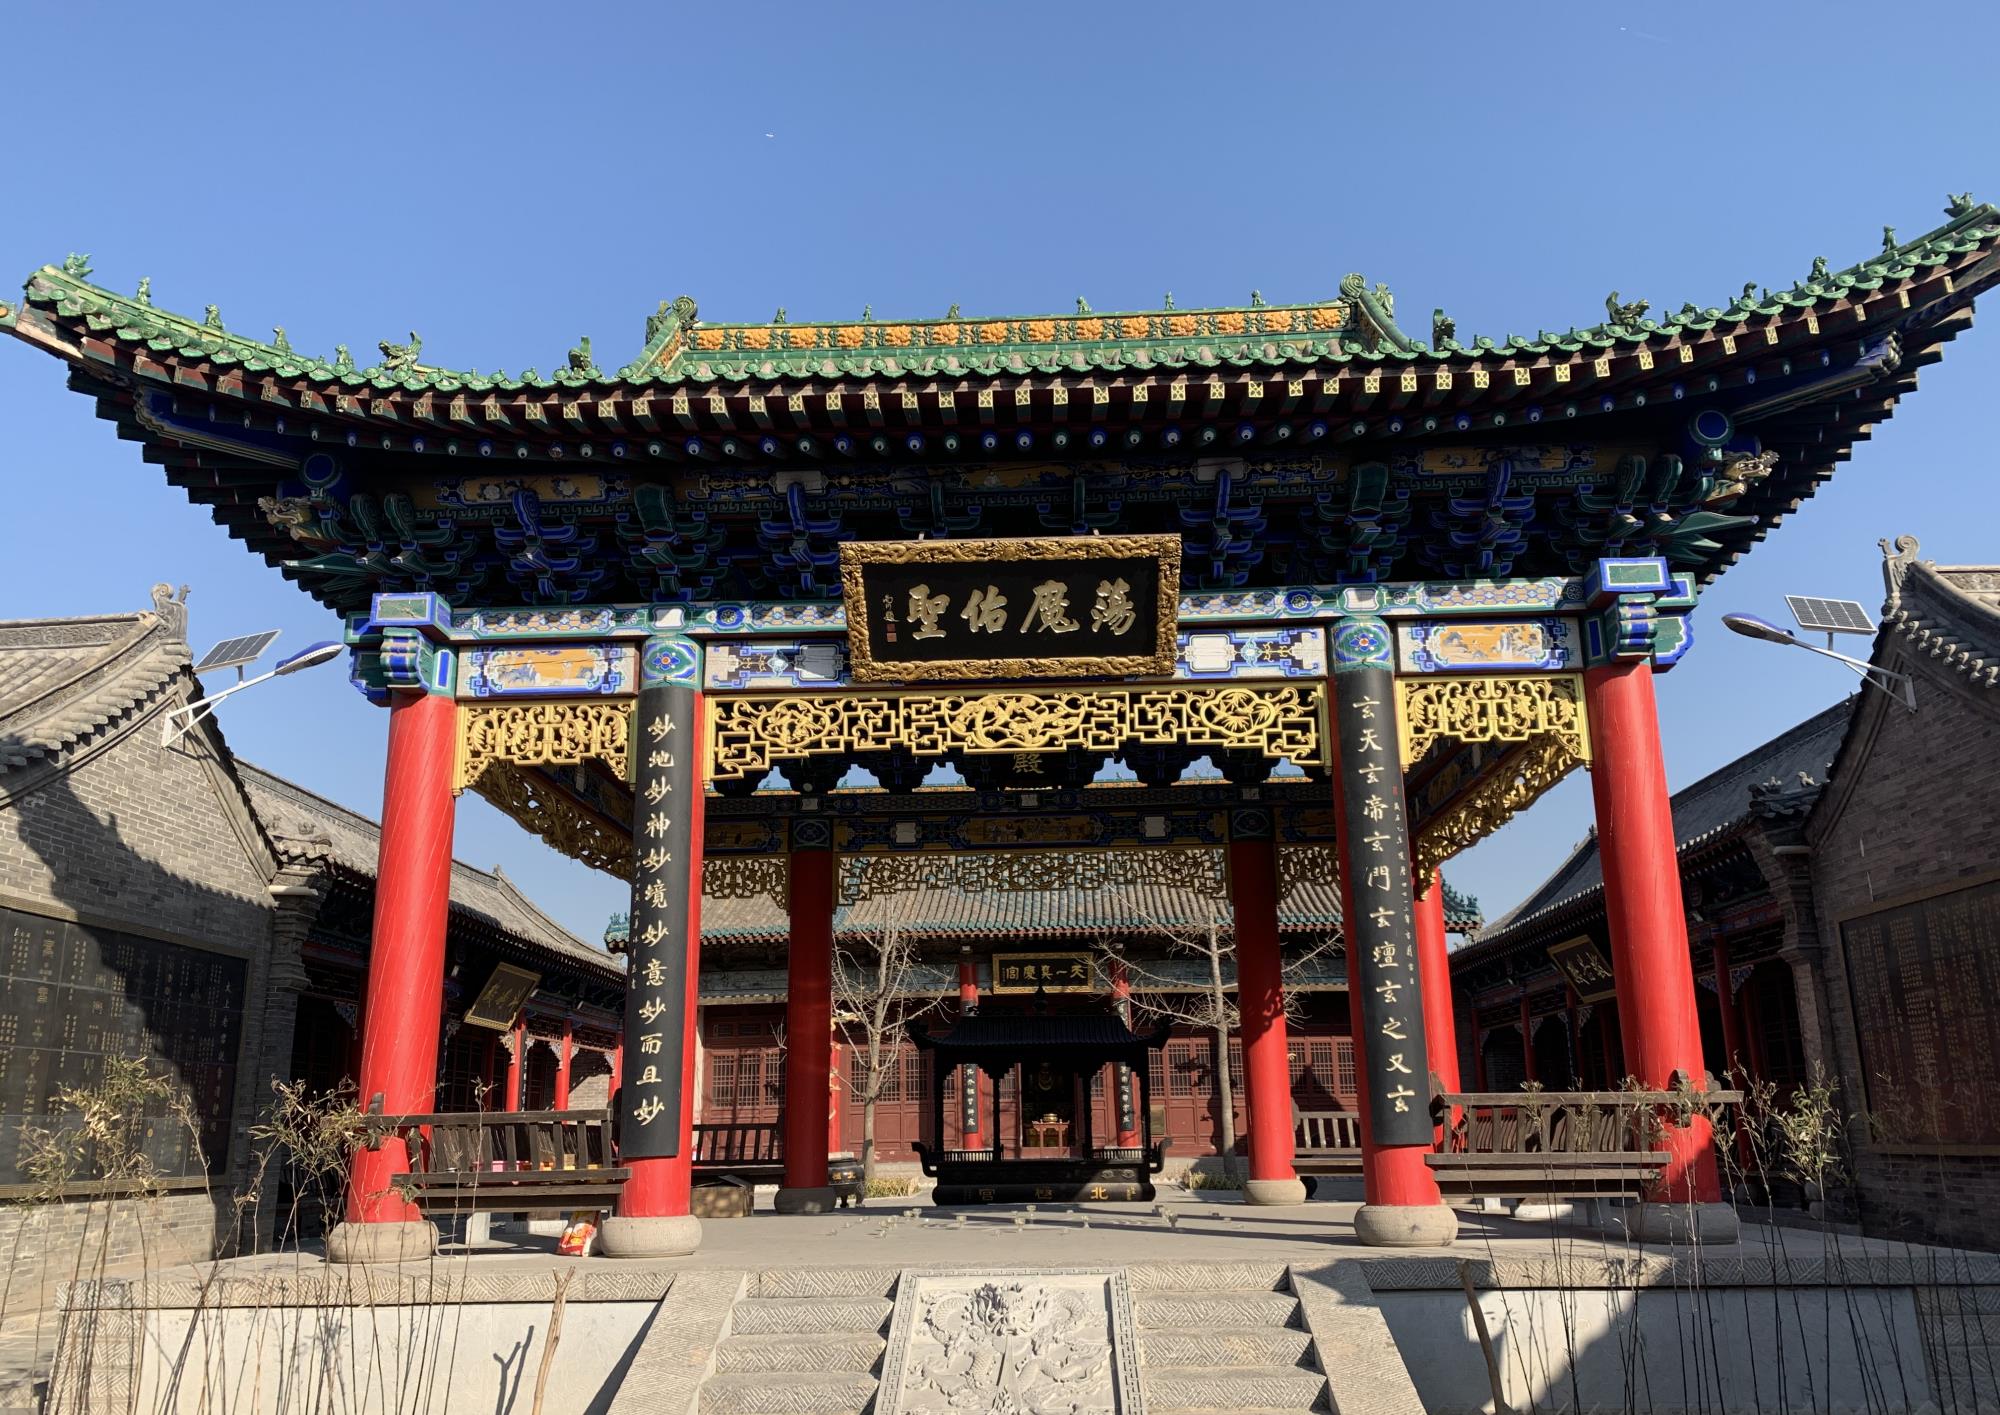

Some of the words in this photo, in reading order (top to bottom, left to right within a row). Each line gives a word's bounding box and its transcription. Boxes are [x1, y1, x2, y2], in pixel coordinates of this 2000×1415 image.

[906, 577, 1137, 640] 蕩魔佑聖
[633, 713, 677, 1126] 妙地妙神妙境妙意妙而且妙
[1352, 695, 1416, 1114] 玄天玄帝玄門玄壇玄之又玄
